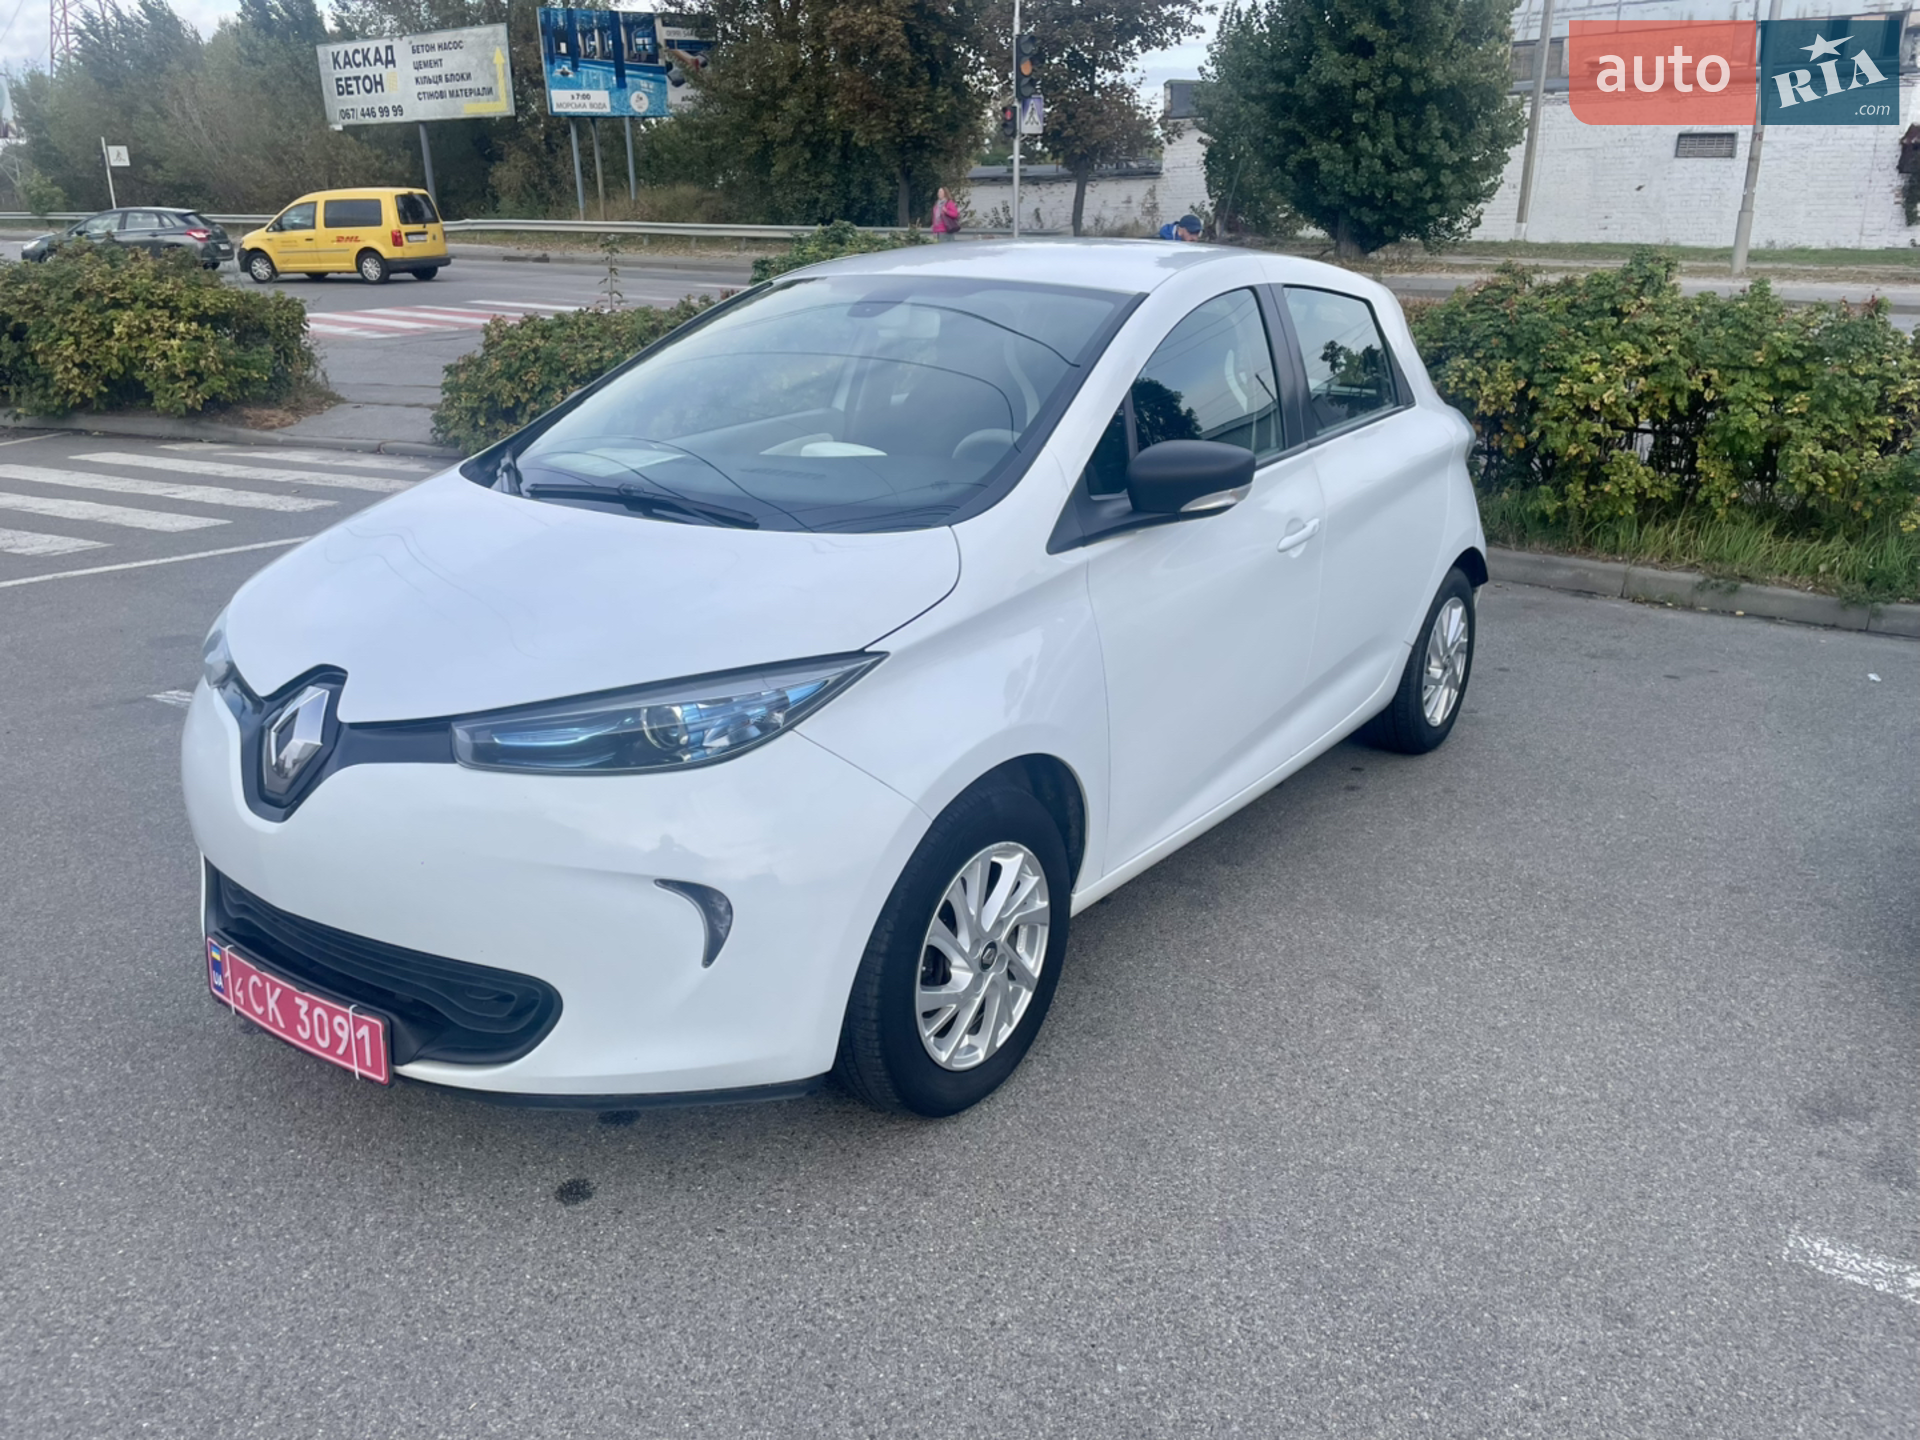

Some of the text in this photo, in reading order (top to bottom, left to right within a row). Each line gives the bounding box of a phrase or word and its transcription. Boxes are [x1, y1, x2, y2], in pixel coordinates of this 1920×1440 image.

[411, 40, 464, 54] БЕТОН НАСОС
[331, 45, 396, 70] КАСКАД
[413, 58, 443, 71] ЦЕМЕНТ
[335, 73, 385, 97] БЕТОН
[414, 72, 472, 86] КІЛЬЦЯ БЛОКИ
[417, 86, 494, 101] СТІНОВІ МАТЕРІАЛИ
[576, 92, 591, 100] 7:00
[360, 107, 377, 118] 446
[378, 105, 390, 118] 99
[391, 104, 404, 117] 99
[335, 235, 361, 243] DHL
[213, 970, 224, 989] UA
[294, 997, 372, 1067] 3091
